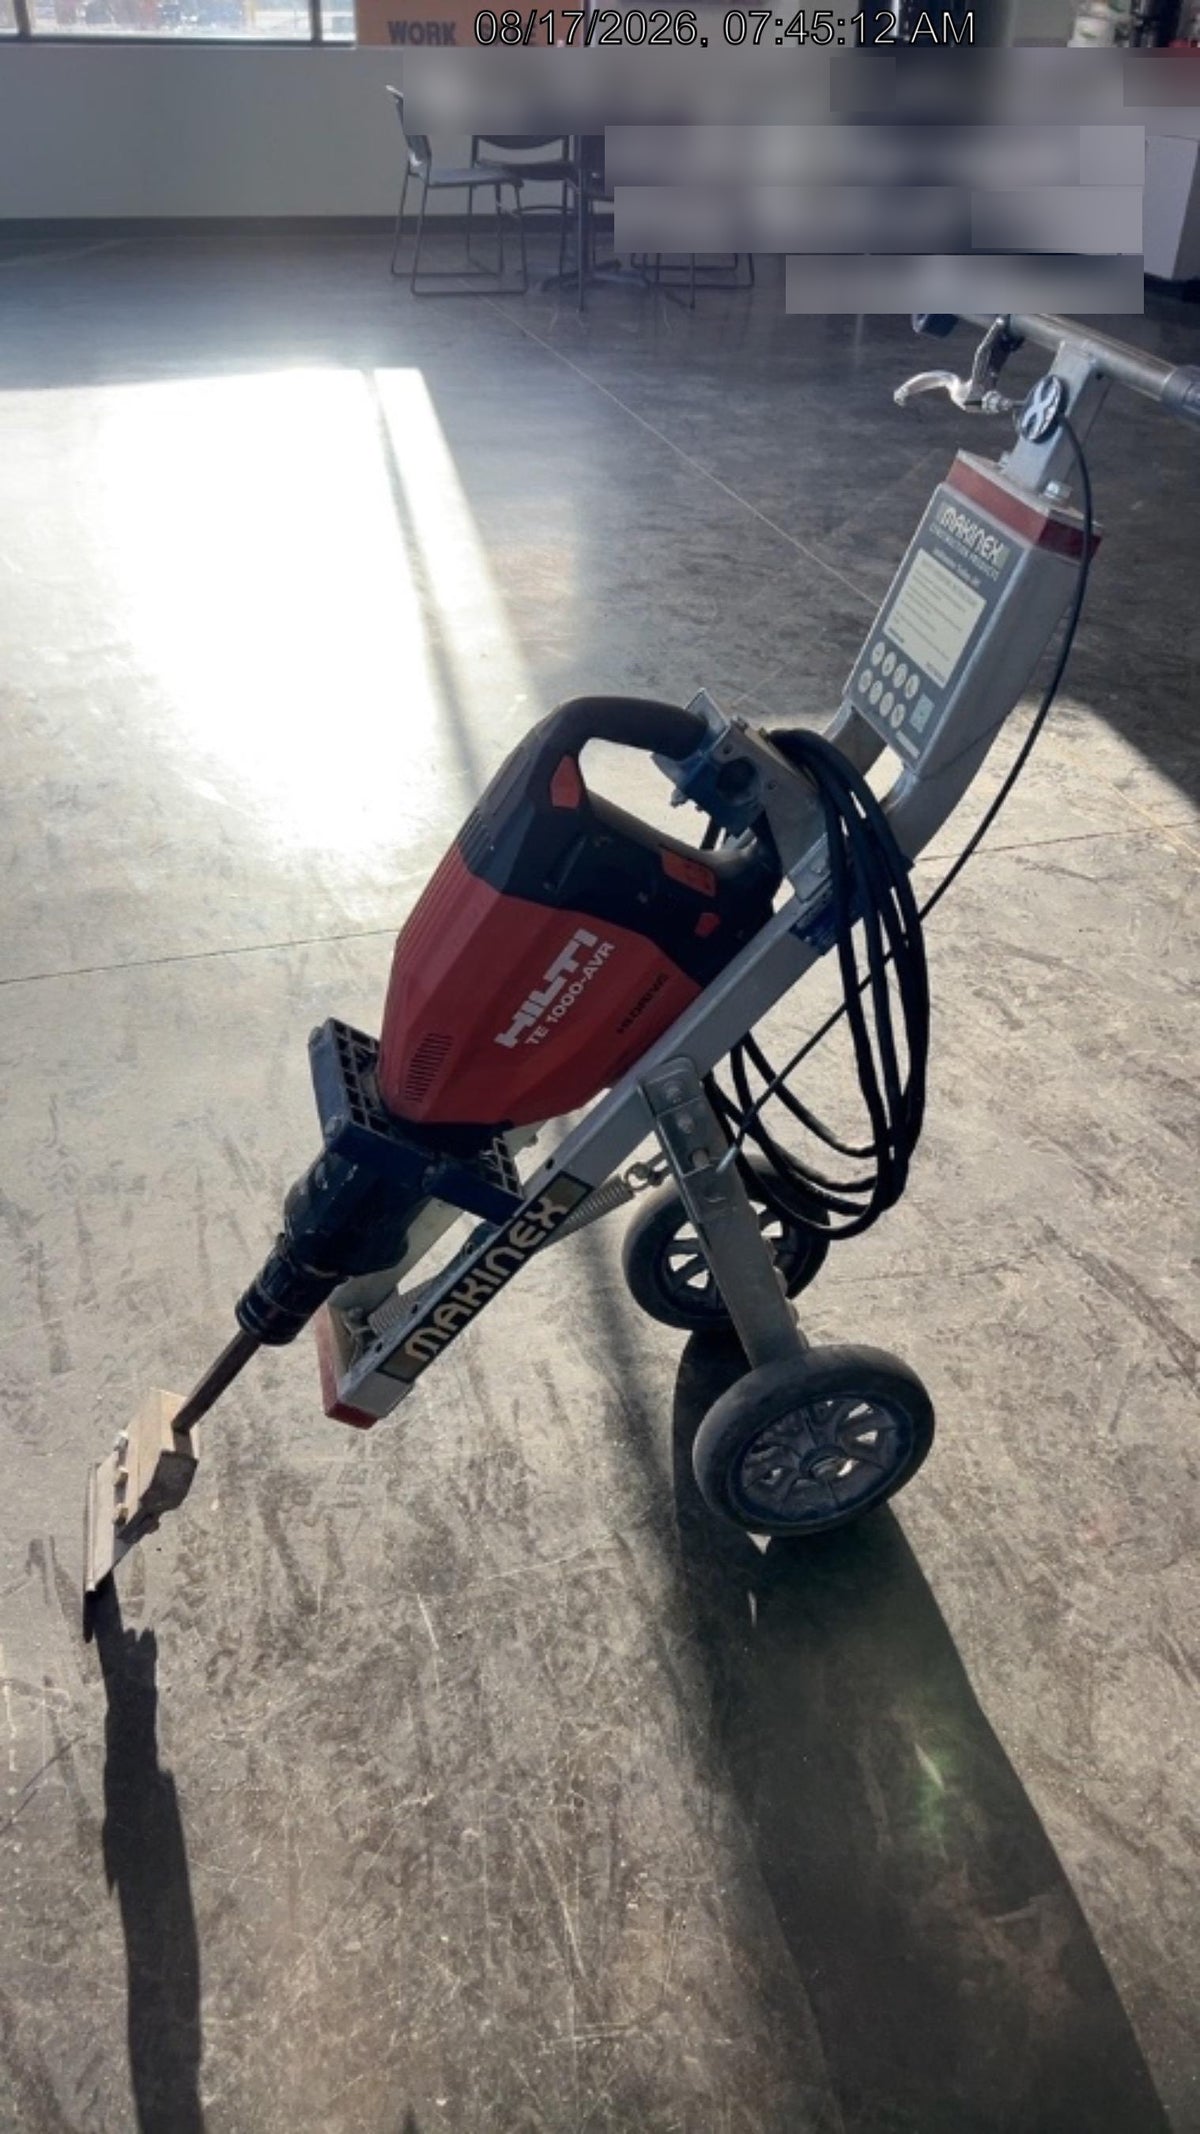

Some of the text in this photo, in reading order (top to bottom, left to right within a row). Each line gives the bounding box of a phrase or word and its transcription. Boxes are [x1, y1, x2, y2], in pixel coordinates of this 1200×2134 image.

[388, 21, 456, 46] WORK
[940, 506, 1004, 566] MAKINEX
[494, 928, 598, 1049] HILTI
[525, 942, 616, 1045] TE 1000-AVR
[404, 1197, 570, 1362] MAKINEX
